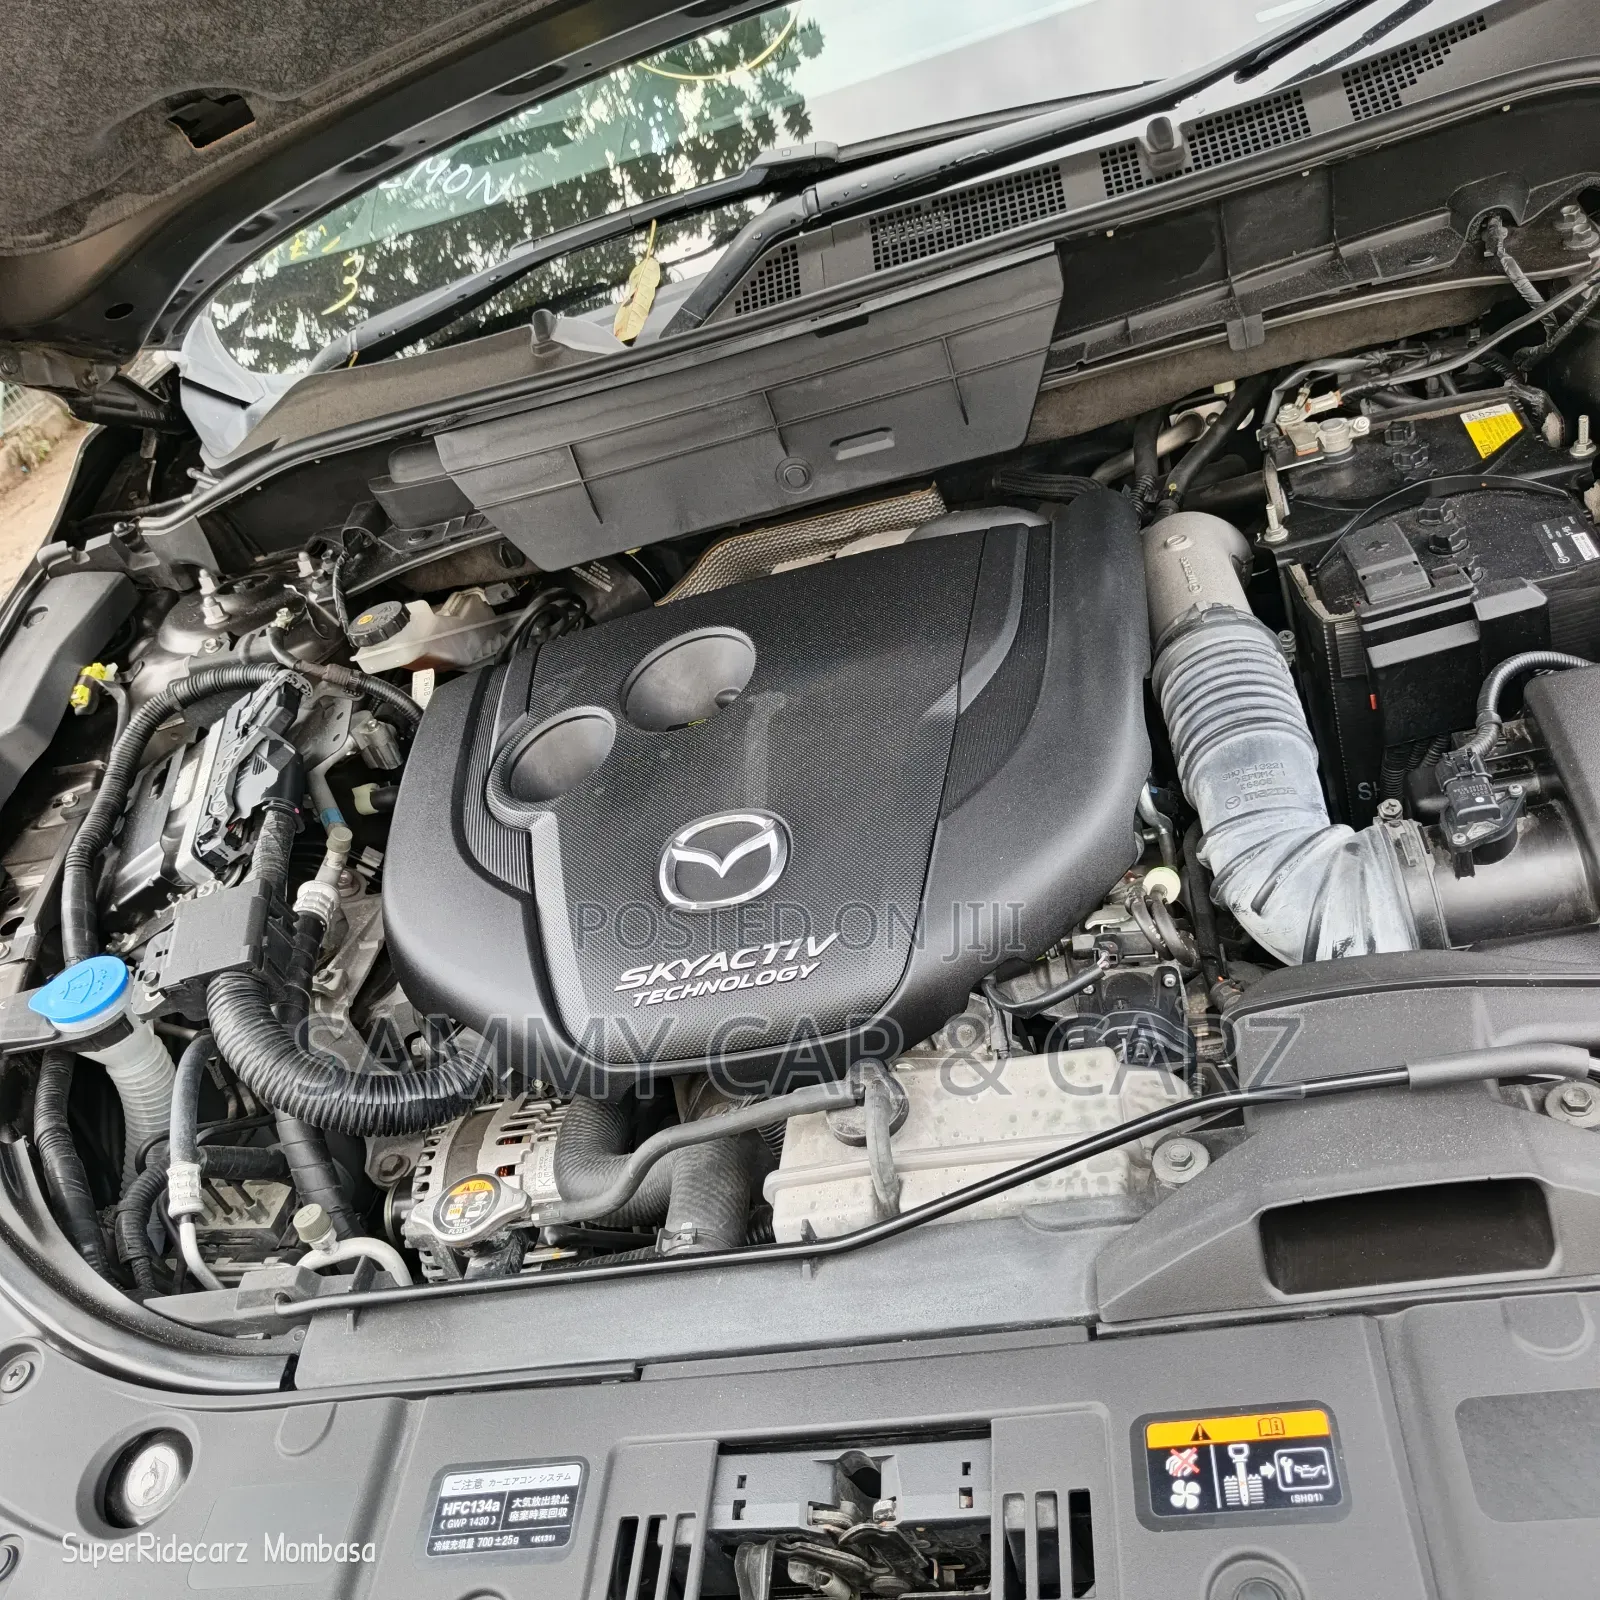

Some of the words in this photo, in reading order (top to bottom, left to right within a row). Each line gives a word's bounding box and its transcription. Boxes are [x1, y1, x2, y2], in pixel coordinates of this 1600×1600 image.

[614, 932, 841, 992] SKYACTIV
[632, 962, 822, 1008] TECHNOLOGY
[451, 1478, 484, 1491] ご注意
[488, 1475, 537, 1487] カーエアコン
[539, 1472, 571, 1483] システム
[511, 1494, 570, 1509] 大気放出禁止
[1290, 1493, 1324, 1503] (SH01)
[441, 1499, 501, 1516] HFC134a
[508, 1507, 568, 1522] 廃棄時要回収
